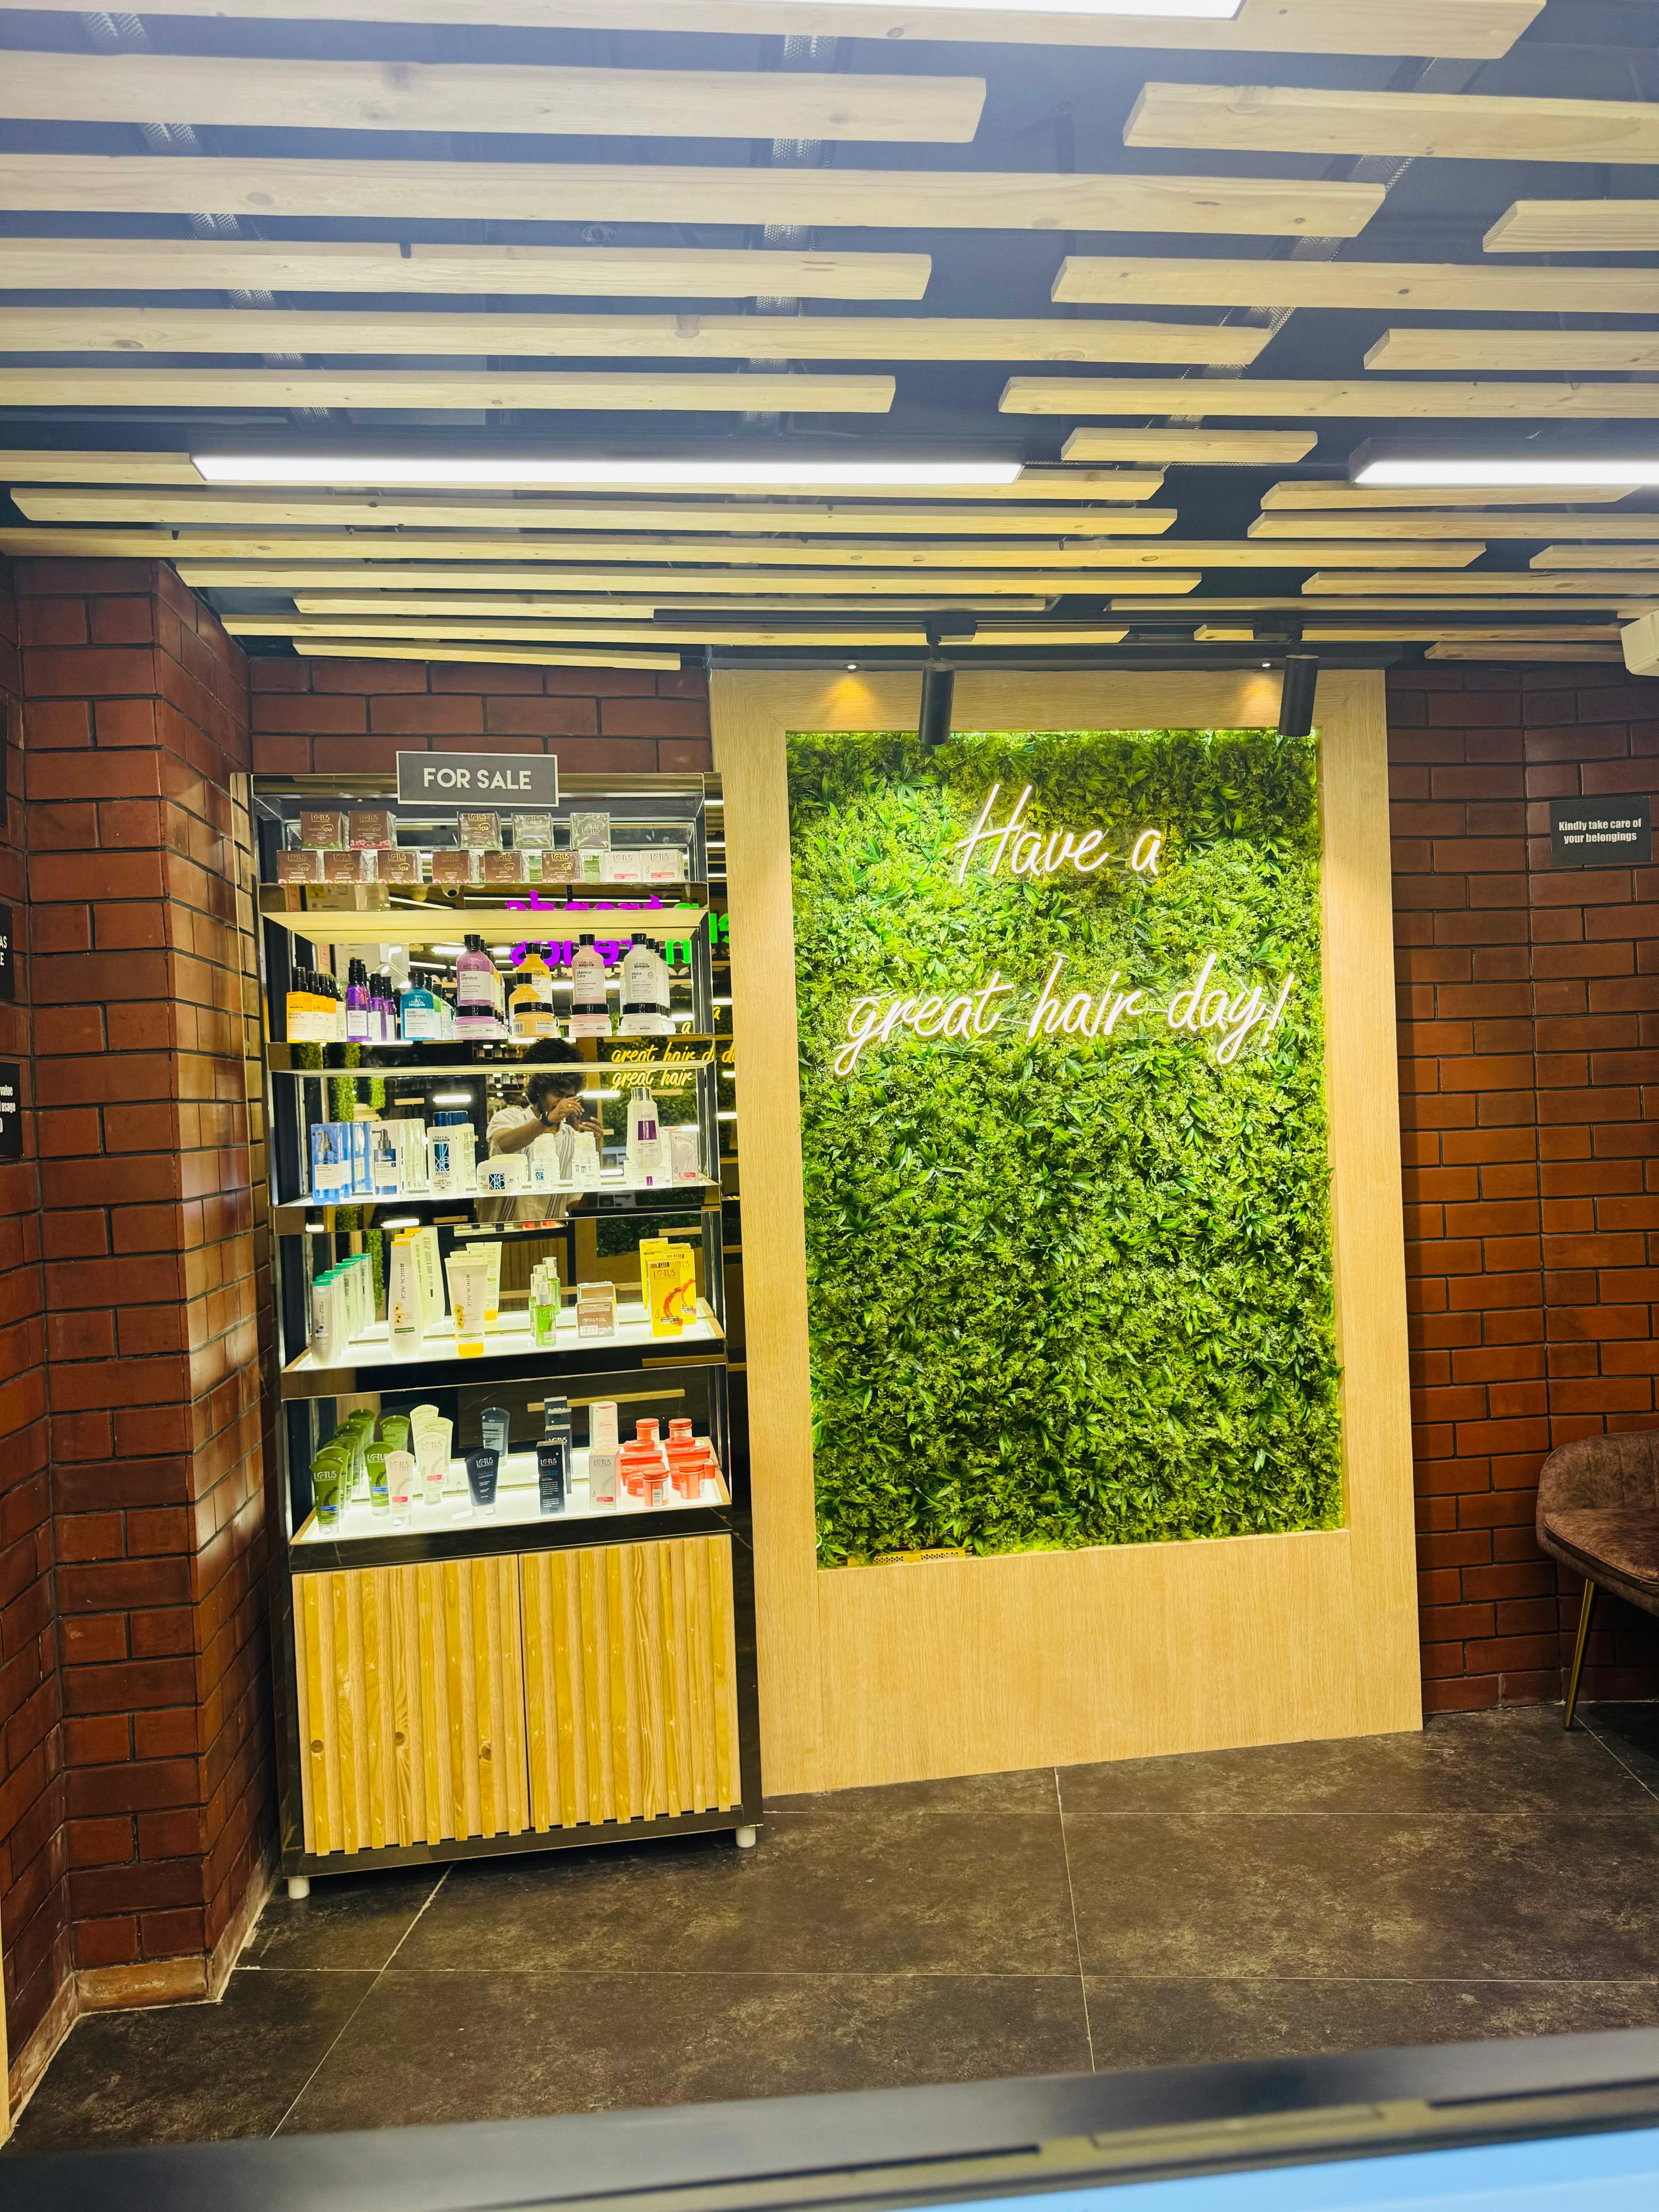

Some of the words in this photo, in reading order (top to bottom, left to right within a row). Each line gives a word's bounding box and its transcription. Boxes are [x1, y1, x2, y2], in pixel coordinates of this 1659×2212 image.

[424, 768, 471, 789] FOR
[477, 769, 532, 791] SALE
[1559, 820, 1587, 831] Kindly
[1588, 820, 1608, 830] take
[1610, 819, 1630, 828] care
[1632, 818, 1642, 827] of
[958, 784, 1107, 884] Have
[1132, 827, 1163, 876] a
[1564, 835, 1584, 844] your
[1586, 832, 1637, 842] belongings
[834, 971, 1014, 1077] great
[1028, 958, 1143, 1040] hair
[1167, 952, 1295, 1066] day!
[611, 1044, 659, 1063] great
[663, 1042, 696, 1061] hair
[660, 1069, 693, 1086] hair
[2, 1102, 16, 1113] usage
[653, 1269, 676, 1277] LOTUS
[476, 1457, 493, 1466] LOTUS
[314, 1470, 337, 1479] LOTUS
